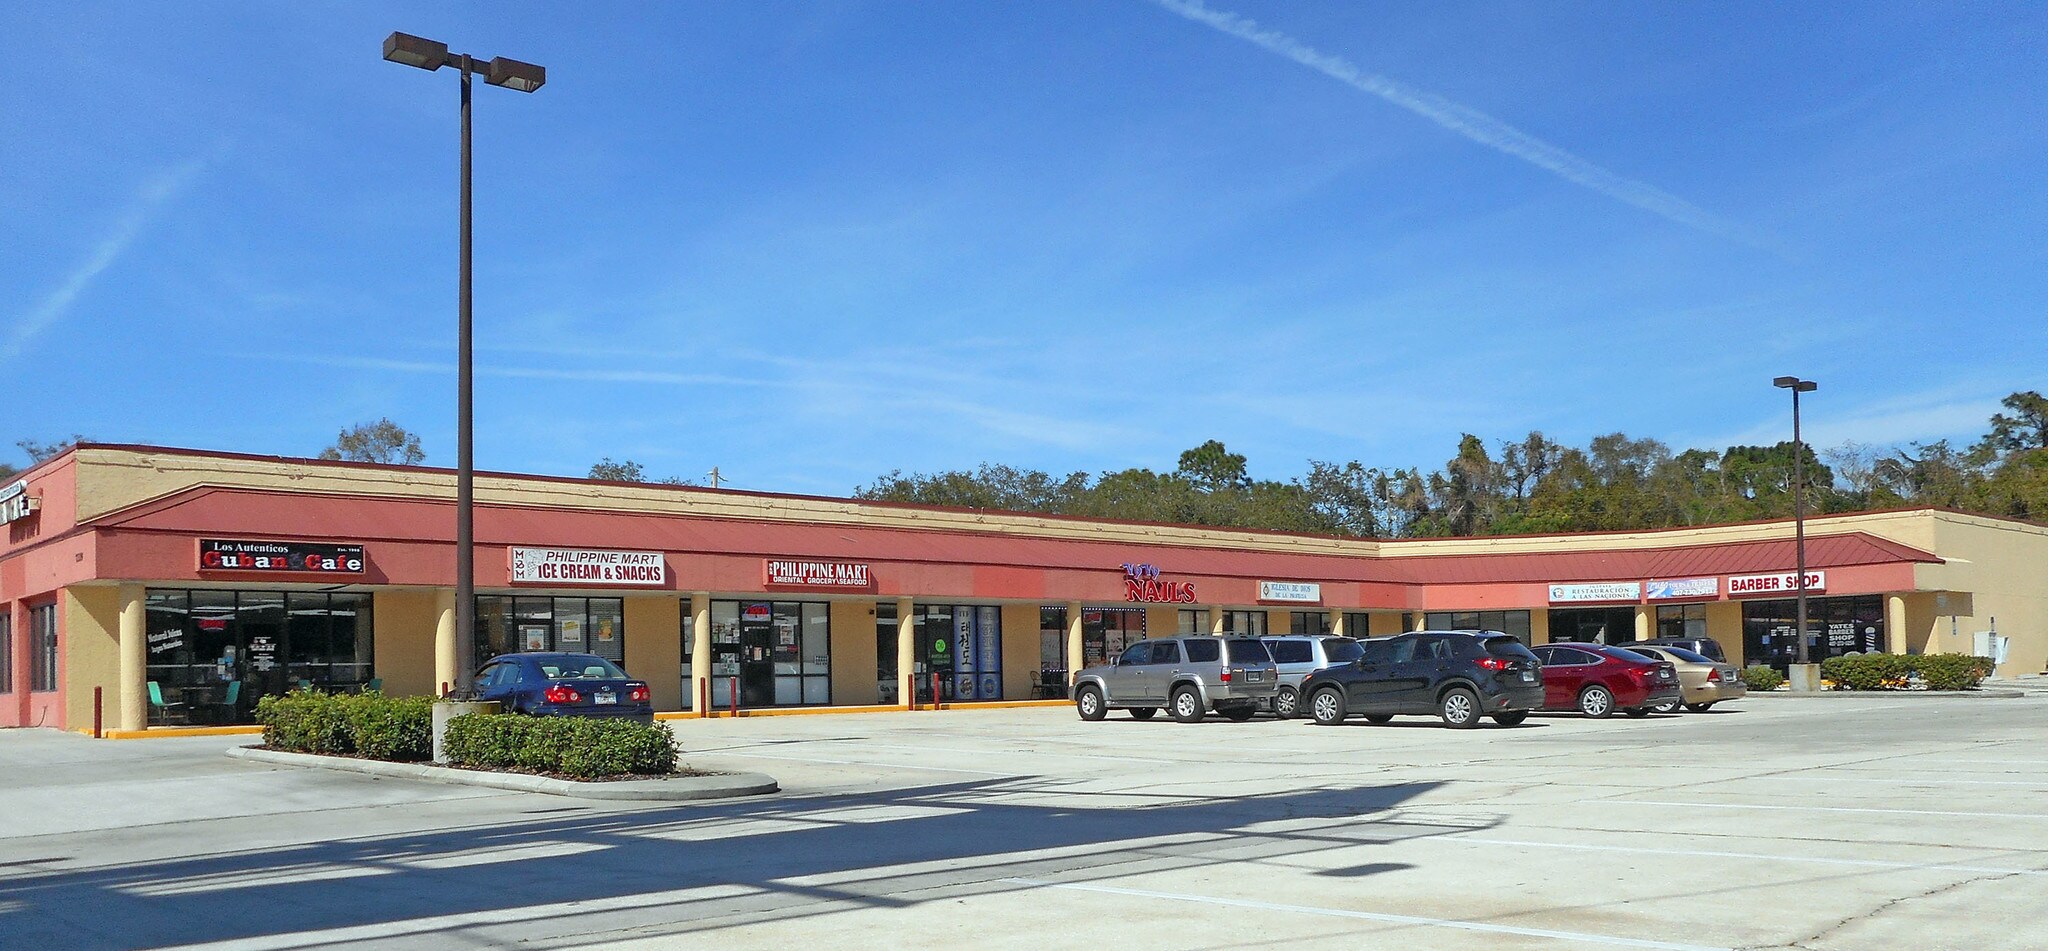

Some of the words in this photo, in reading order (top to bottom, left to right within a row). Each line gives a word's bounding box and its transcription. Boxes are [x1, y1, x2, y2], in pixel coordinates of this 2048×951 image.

[214, 542, 232, 551] Los
[235, 543, 289, 553] Autenticos
[204, 551, 288, 569] Cuban
[305, 554, 362, 571] Cafe
[546, 551, 618, 564] PHILIPPINE
[621, 554, 657, 565] MART
[538, 563, 557, 579] ICE
[560, 564, 602, 580] CREAM
[604, 567, 613, 580] &
[615, 565, 661, 581] SNACKS
[773, 561, 834, 578] PHILIPPINE
[836, 564, 868, 579] MART
[1125, 579, 1197, 604] NAILS
[1271, 583, 1290, 591] IGLESIA
[1731, 577, 1779, 591] BARBER
[1785, 575, 1819, 589] SHOP
[959, 621, 973, 666] 태권도
